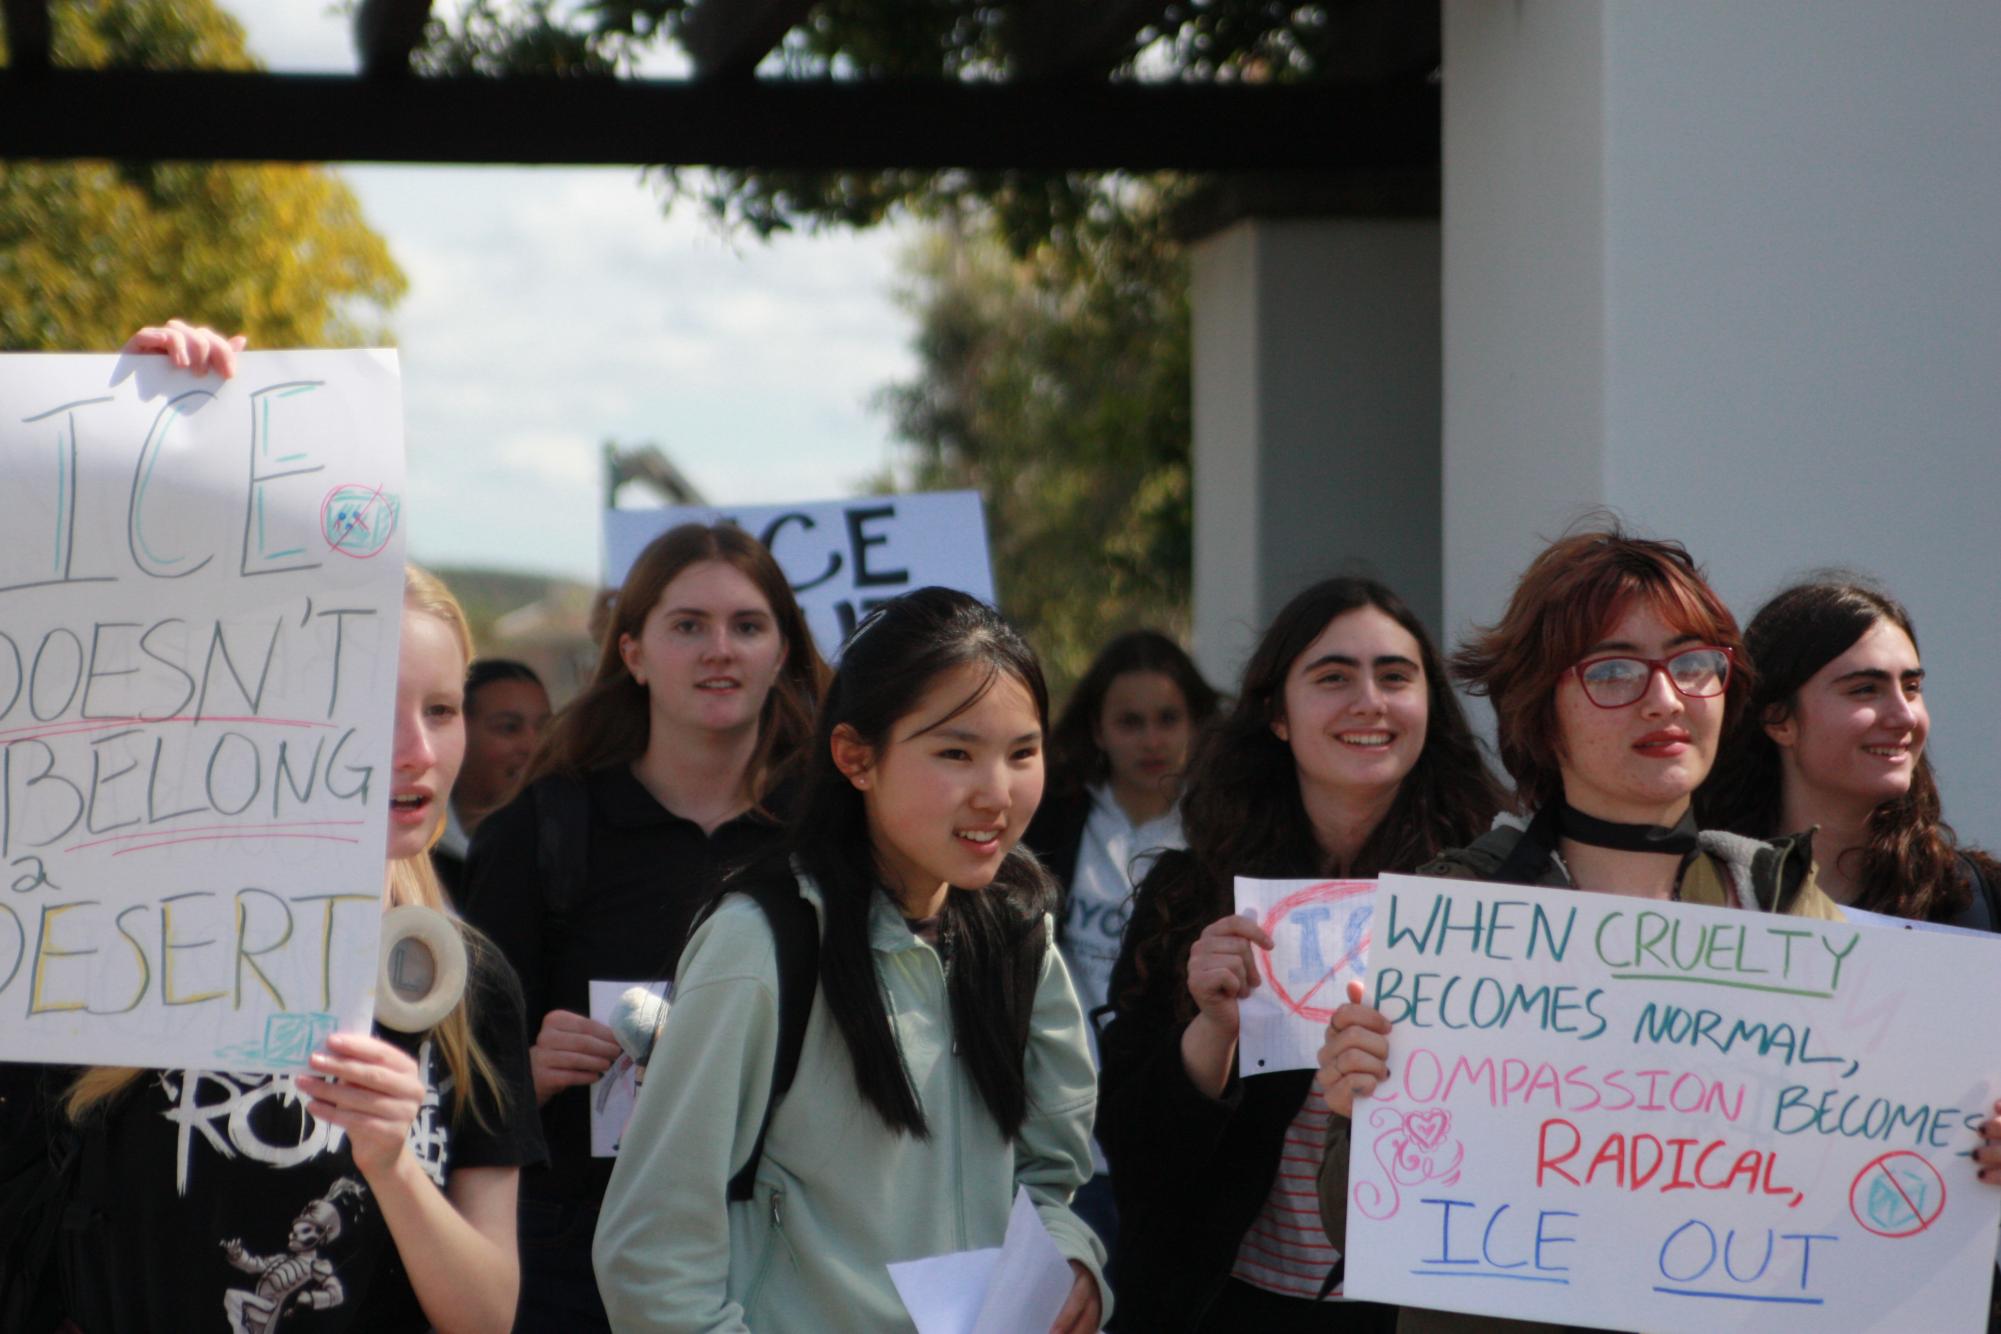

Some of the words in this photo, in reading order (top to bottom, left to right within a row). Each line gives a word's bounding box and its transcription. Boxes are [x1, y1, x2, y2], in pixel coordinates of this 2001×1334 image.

[0, 381, 325, 591] ICE
[716, 506, 909, 592] CE
[3, 729, 373, 857] BELONG
[1387, 894, 1577, 962] WHEN
[1595, 911, 1860, 991] CRUELTY
[1374, 967, 1608, 1040] BECOMES
[1633, 1002, 1860, 1078] NORMAL,
[1370, 1048, 1745, 1121] OMPASSION
[1536, 1118, 1804, 1207] RADICAL,
[1420, 1198, 1579, 1272] ICE
[1659, 1220, 1840, 1289] OUT
